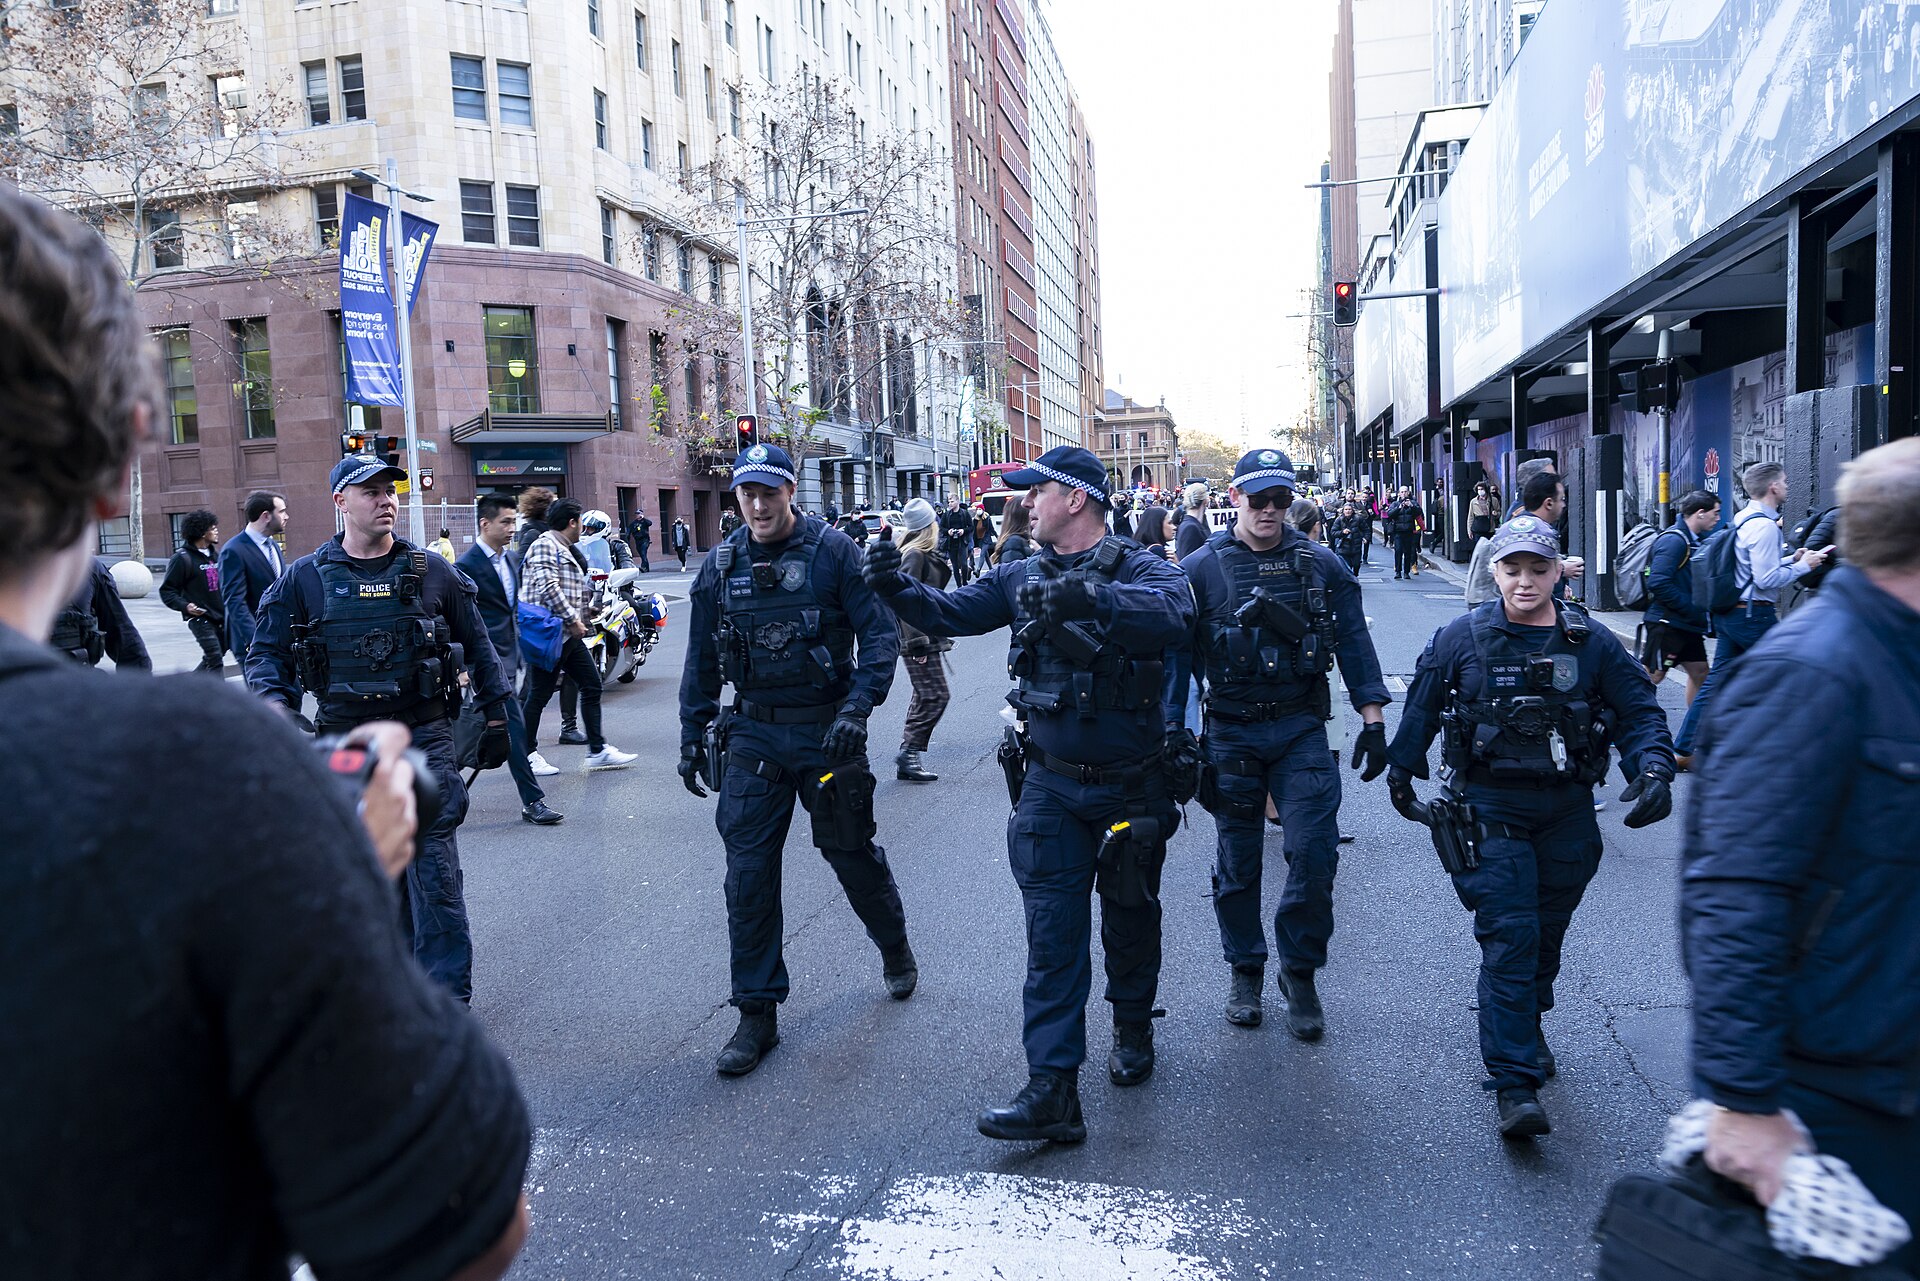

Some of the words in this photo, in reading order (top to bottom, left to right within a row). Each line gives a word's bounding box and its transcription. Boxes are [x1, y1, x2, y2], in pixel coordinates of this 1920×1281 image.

[1585, 109, 1605, 156] NSW
[1704, 477, 1719, 493] NSW
[1258, 561, 1290, 571] POLICE
[359, 583, 391, 593] POLICE
